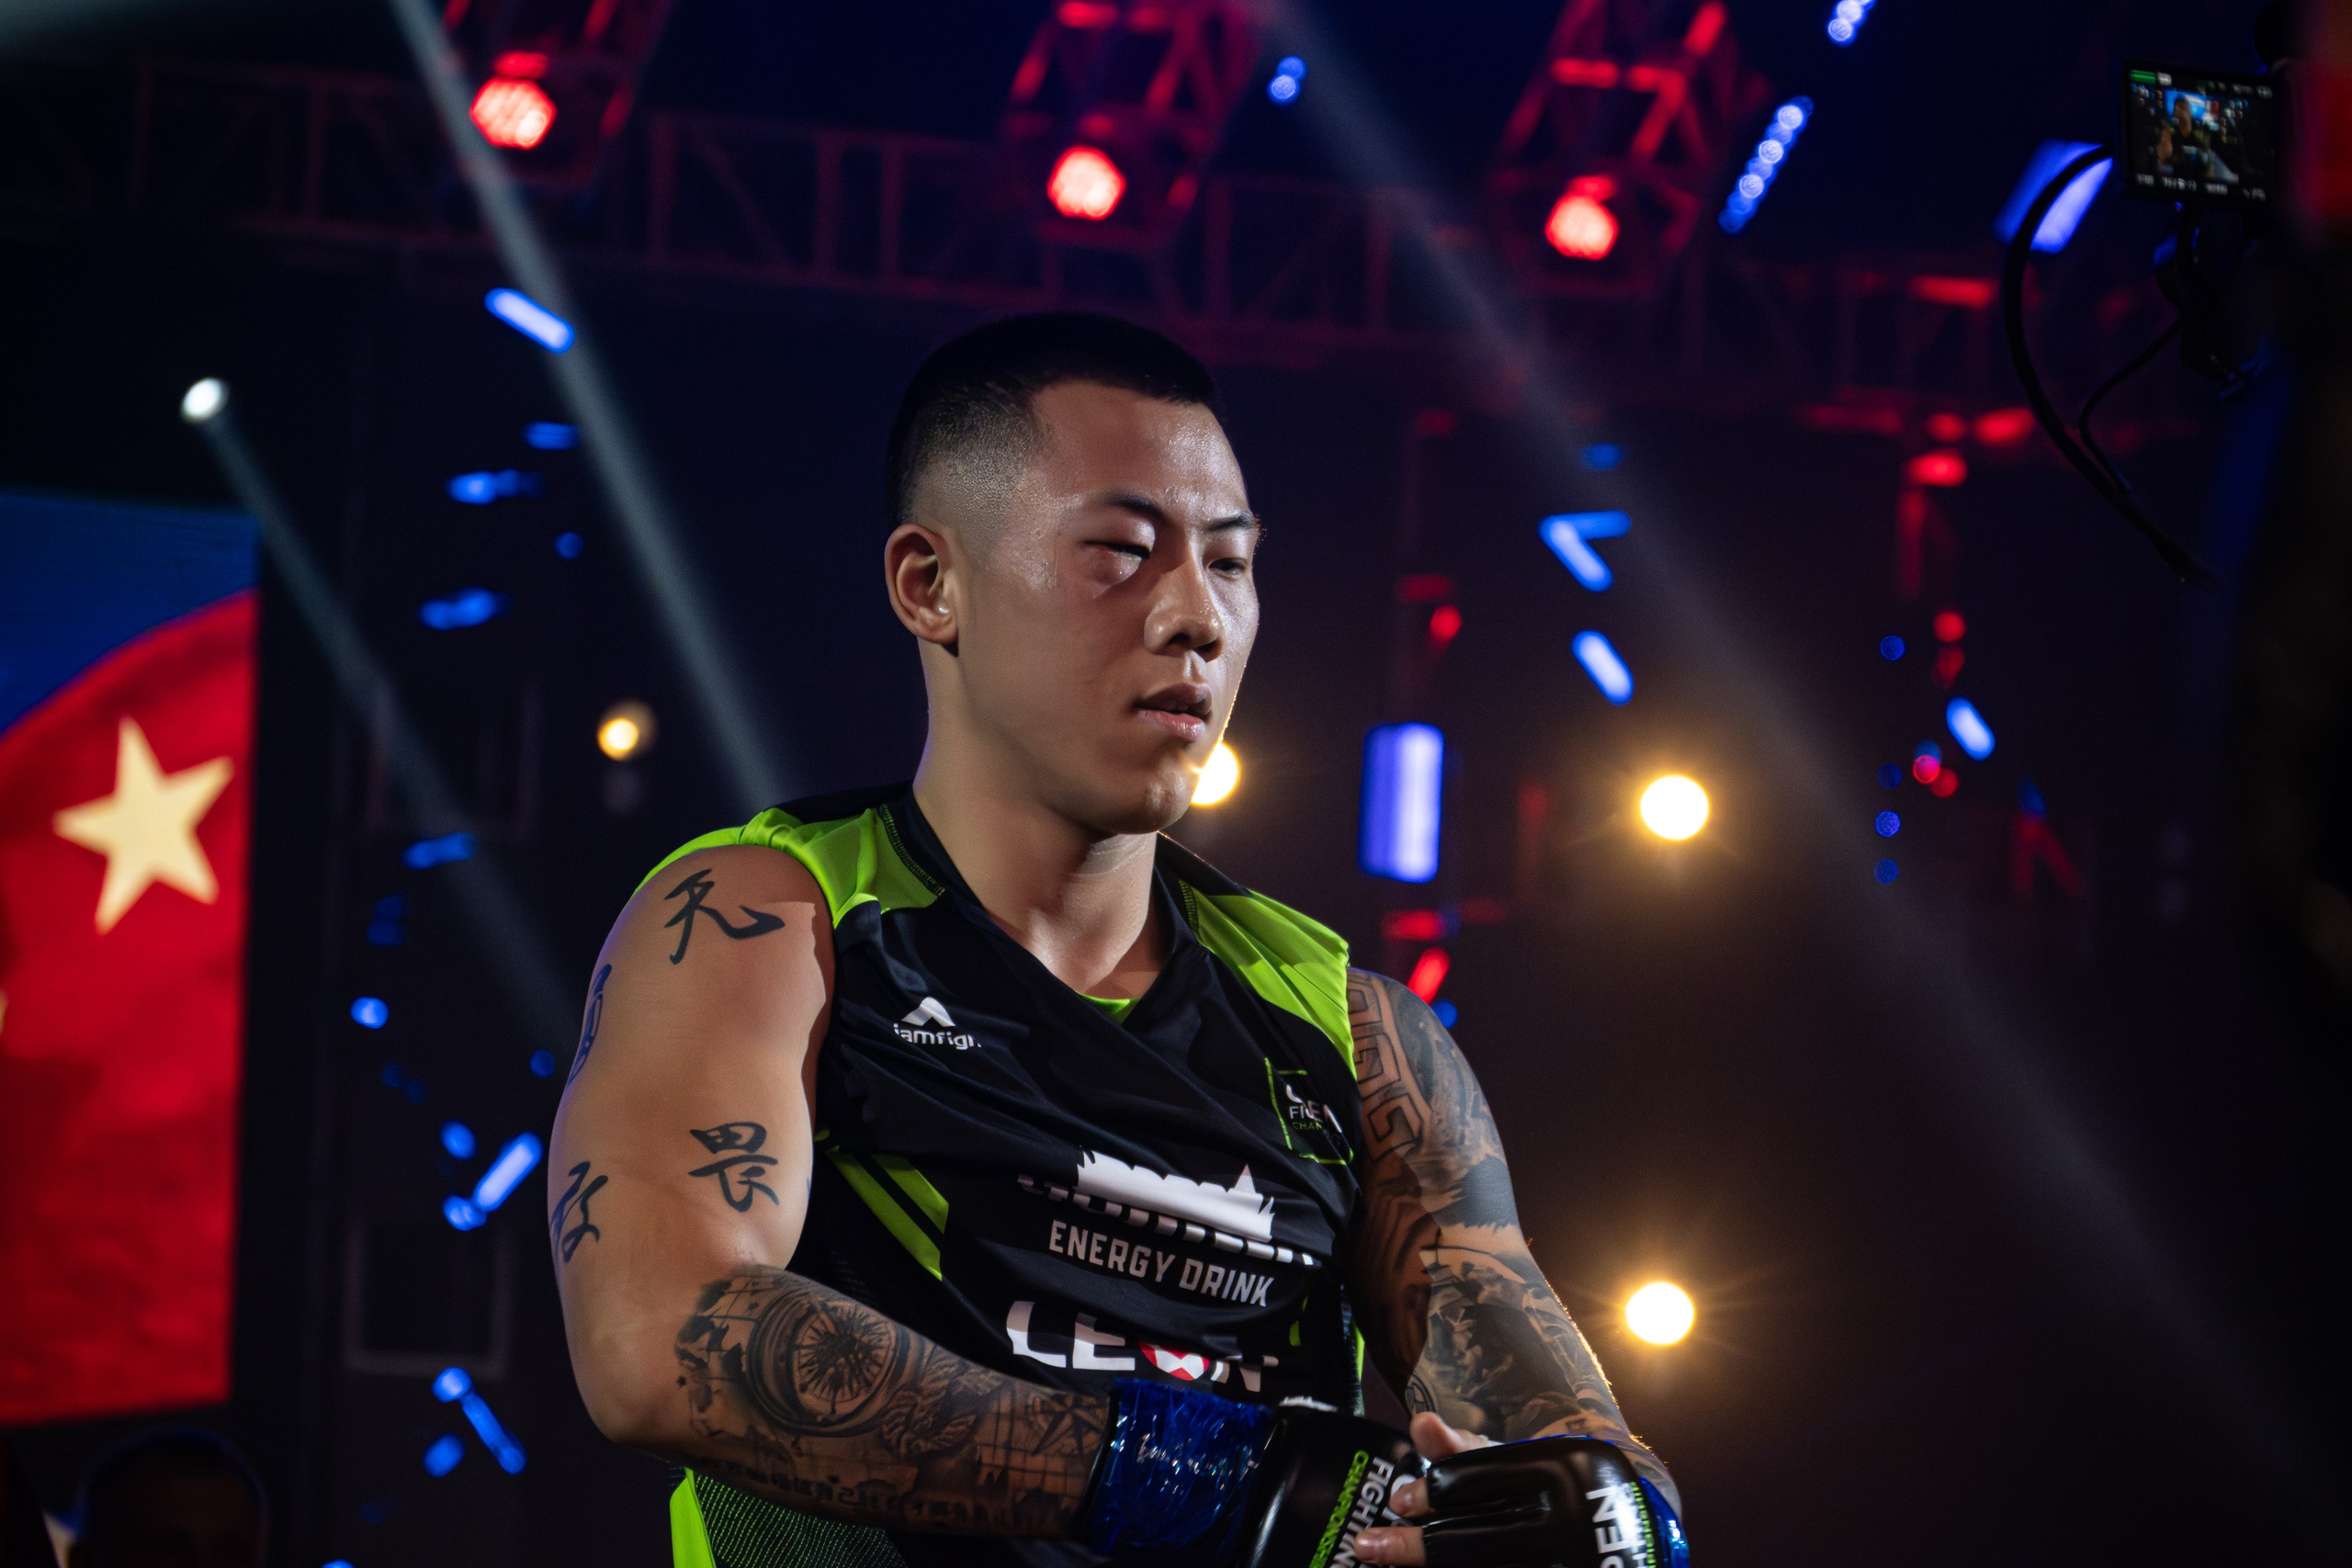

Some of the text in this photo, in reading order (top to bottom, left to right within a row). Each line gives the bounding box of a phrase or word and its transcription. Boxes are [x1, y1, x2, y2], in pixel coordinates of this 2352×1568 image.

[688, 1121, 779, 1213] 畏
[1048, 1219, 1275, 1308] ENERGY DRINK
